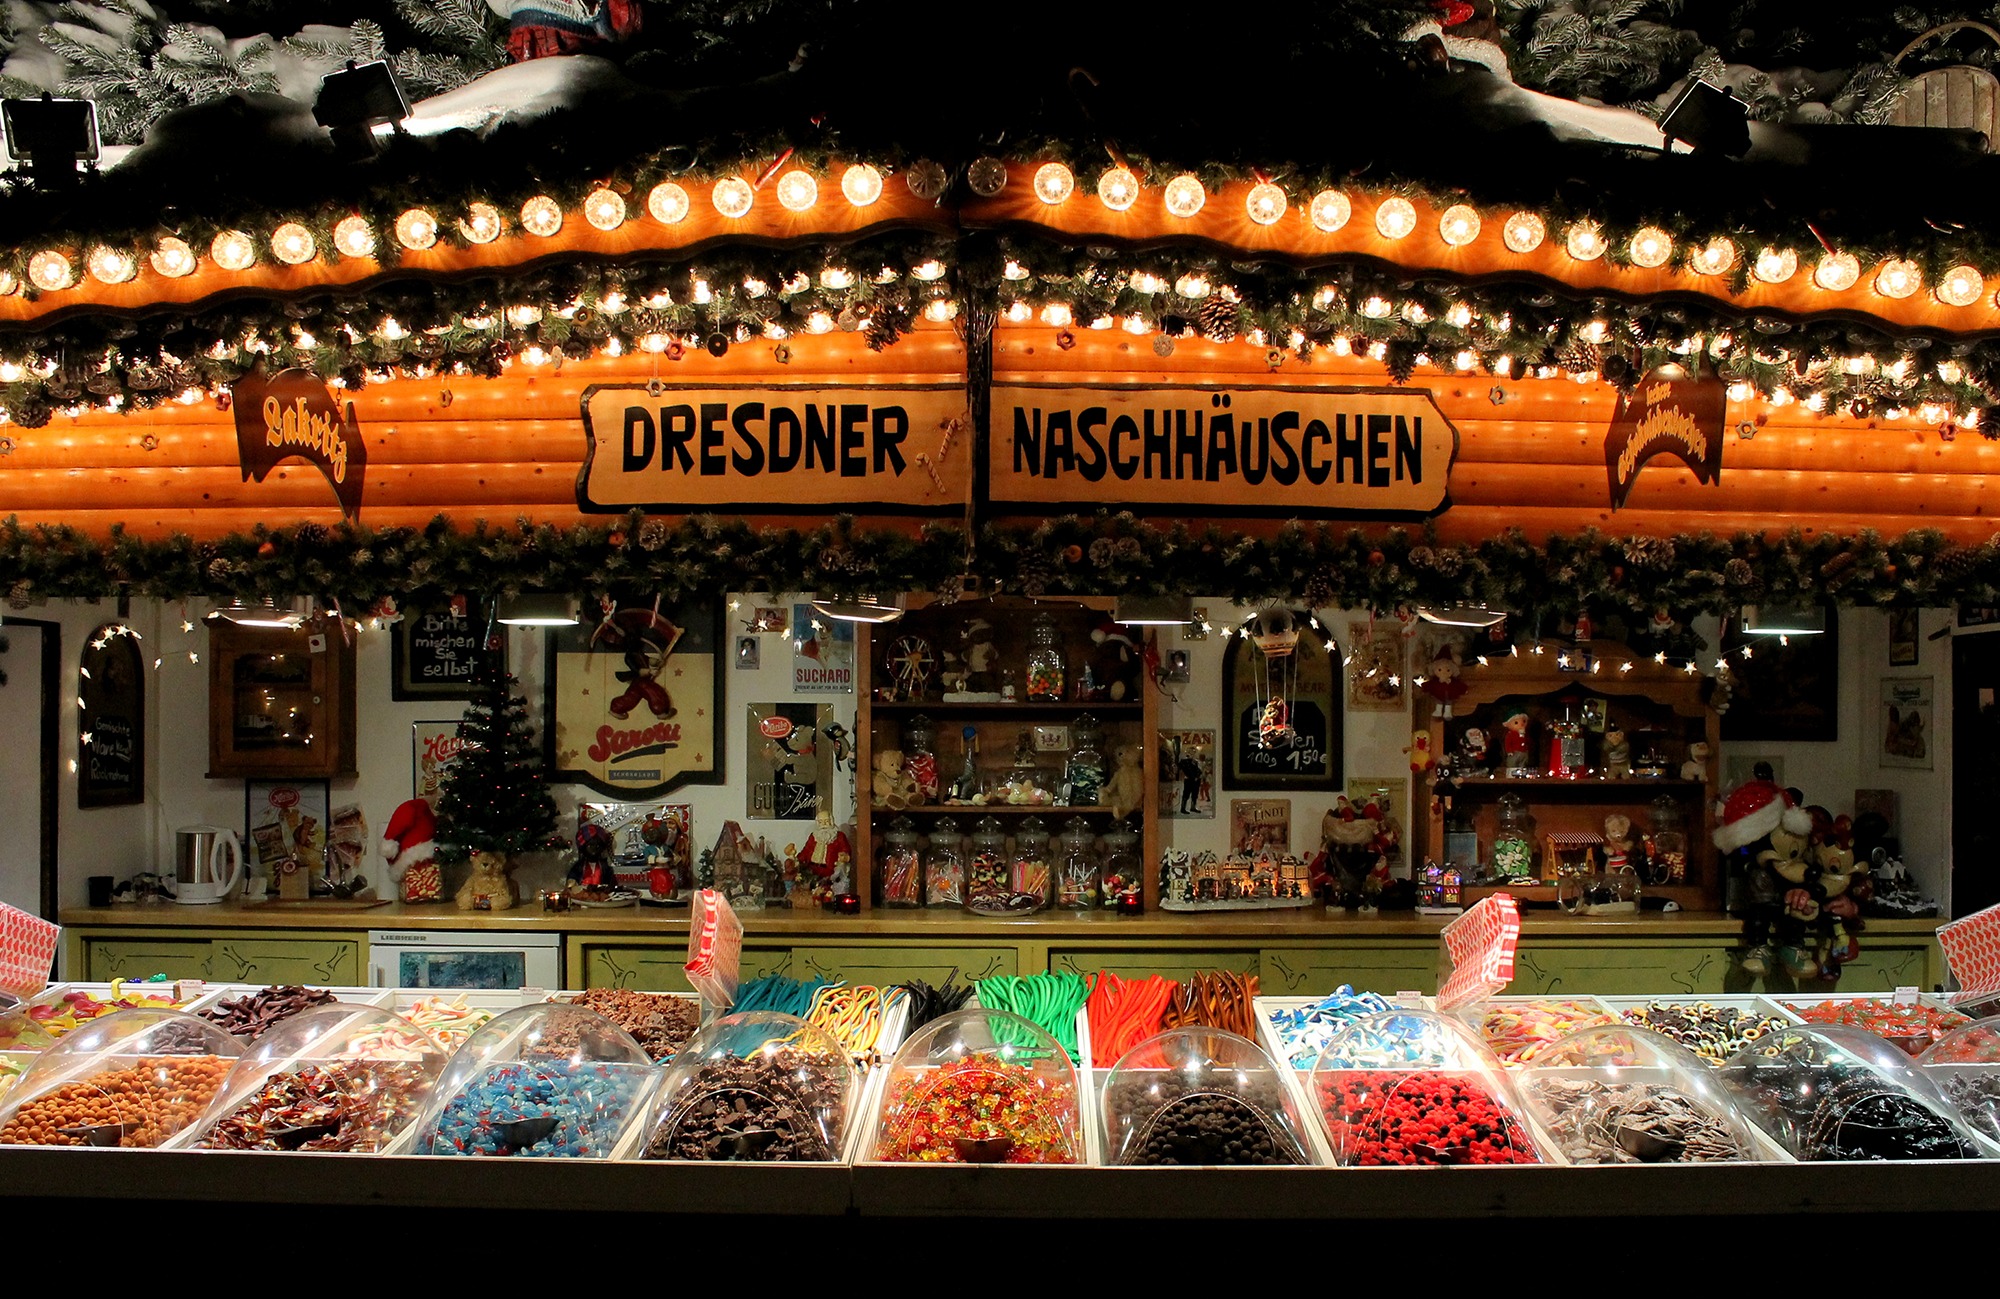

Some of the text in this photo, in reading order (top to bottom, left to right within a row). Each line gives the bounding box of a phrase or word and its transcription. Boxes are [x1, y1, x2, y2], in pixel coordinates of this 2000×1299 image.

[263, 395, 347, 484] Lakritz
[622, 393, 1422, 487] DRESDNER NASCHHÄUSCHEN
[422, 614, 469, 632] Bitte
[415, 633, 475, 649] mischen
[434, 647, 458, 661] Sie
[423, 656, 479, 677] selbst
[796, 668, 851, 684] SUCHARD
[1296, 683, 1325, 693] BEAR
[588, 722, 682, 762] Sarotti
[1182, 732, 1212, 745] ZAN
[1254, 806, 1286, 822] LINDT
